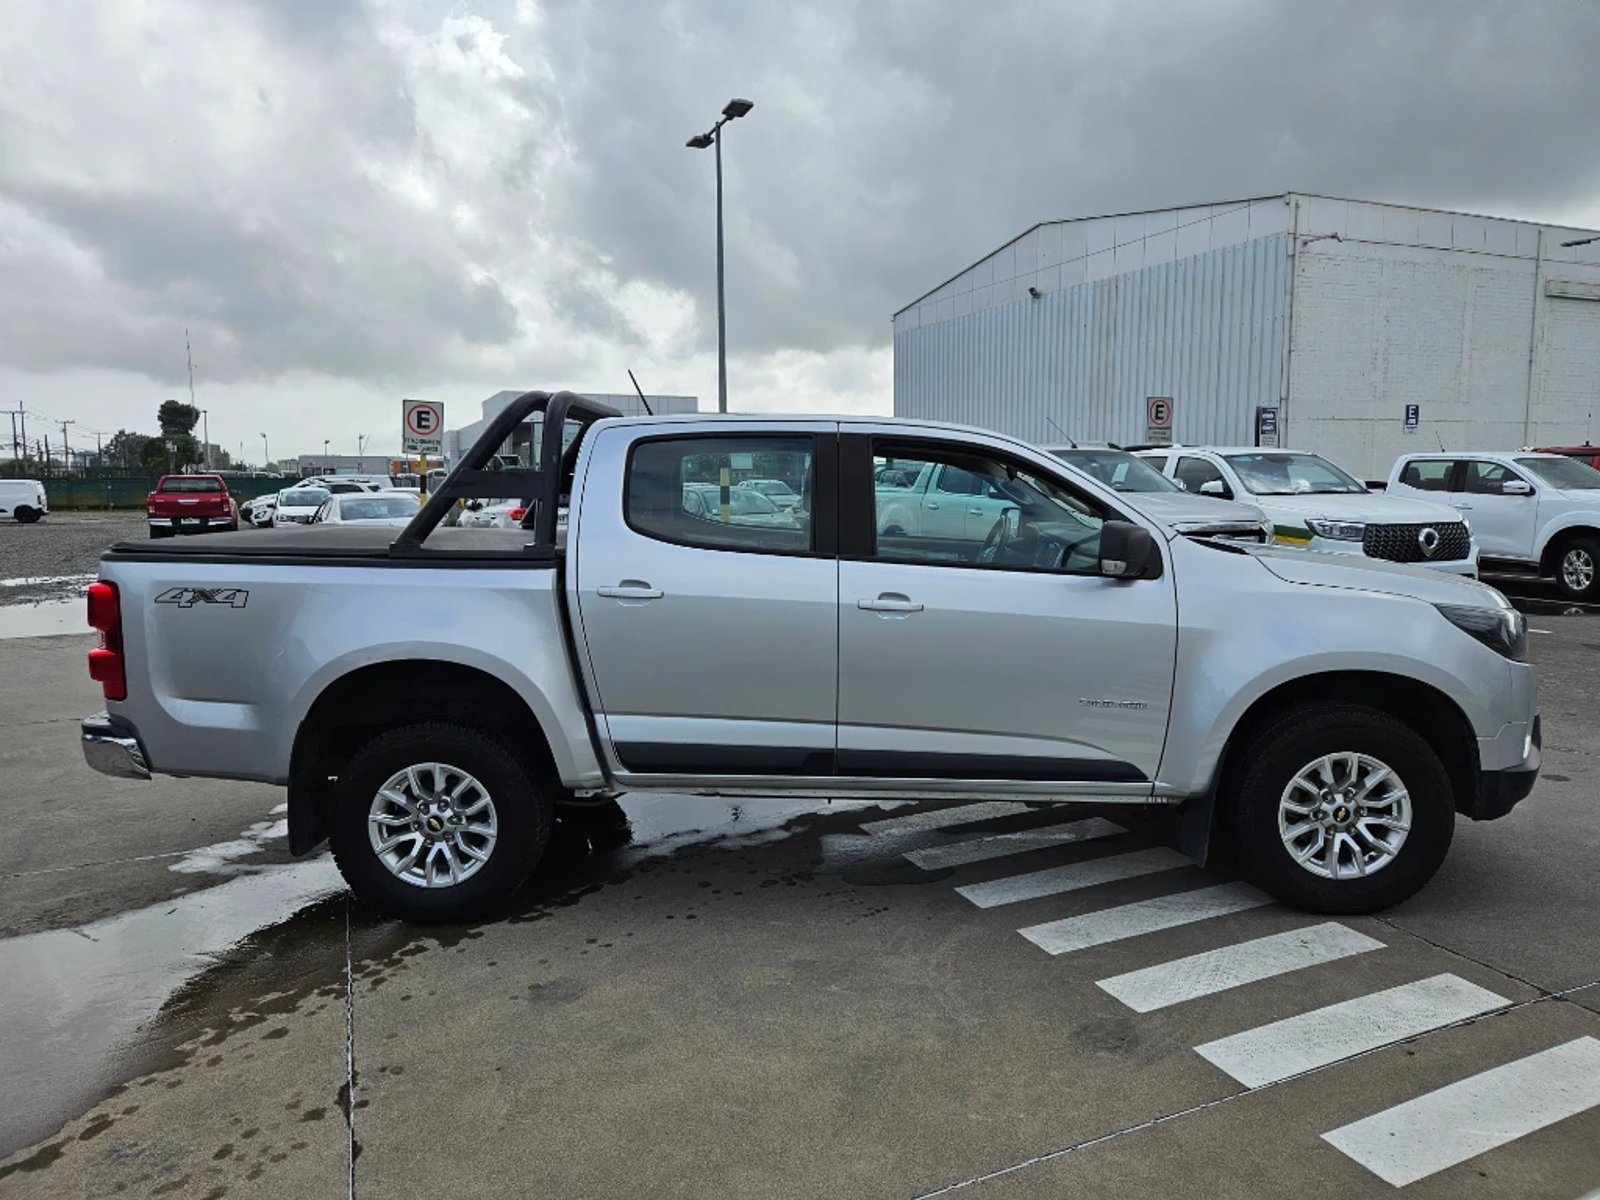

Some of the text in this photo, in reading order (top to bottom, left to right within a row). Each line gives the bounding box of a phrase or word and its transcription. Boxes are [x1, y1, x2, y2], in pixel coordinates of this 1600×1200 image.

[416, 410, 431, 429] E
[1155, 404, 1165, 420] E
[1409, 405, 1416, 418] E
